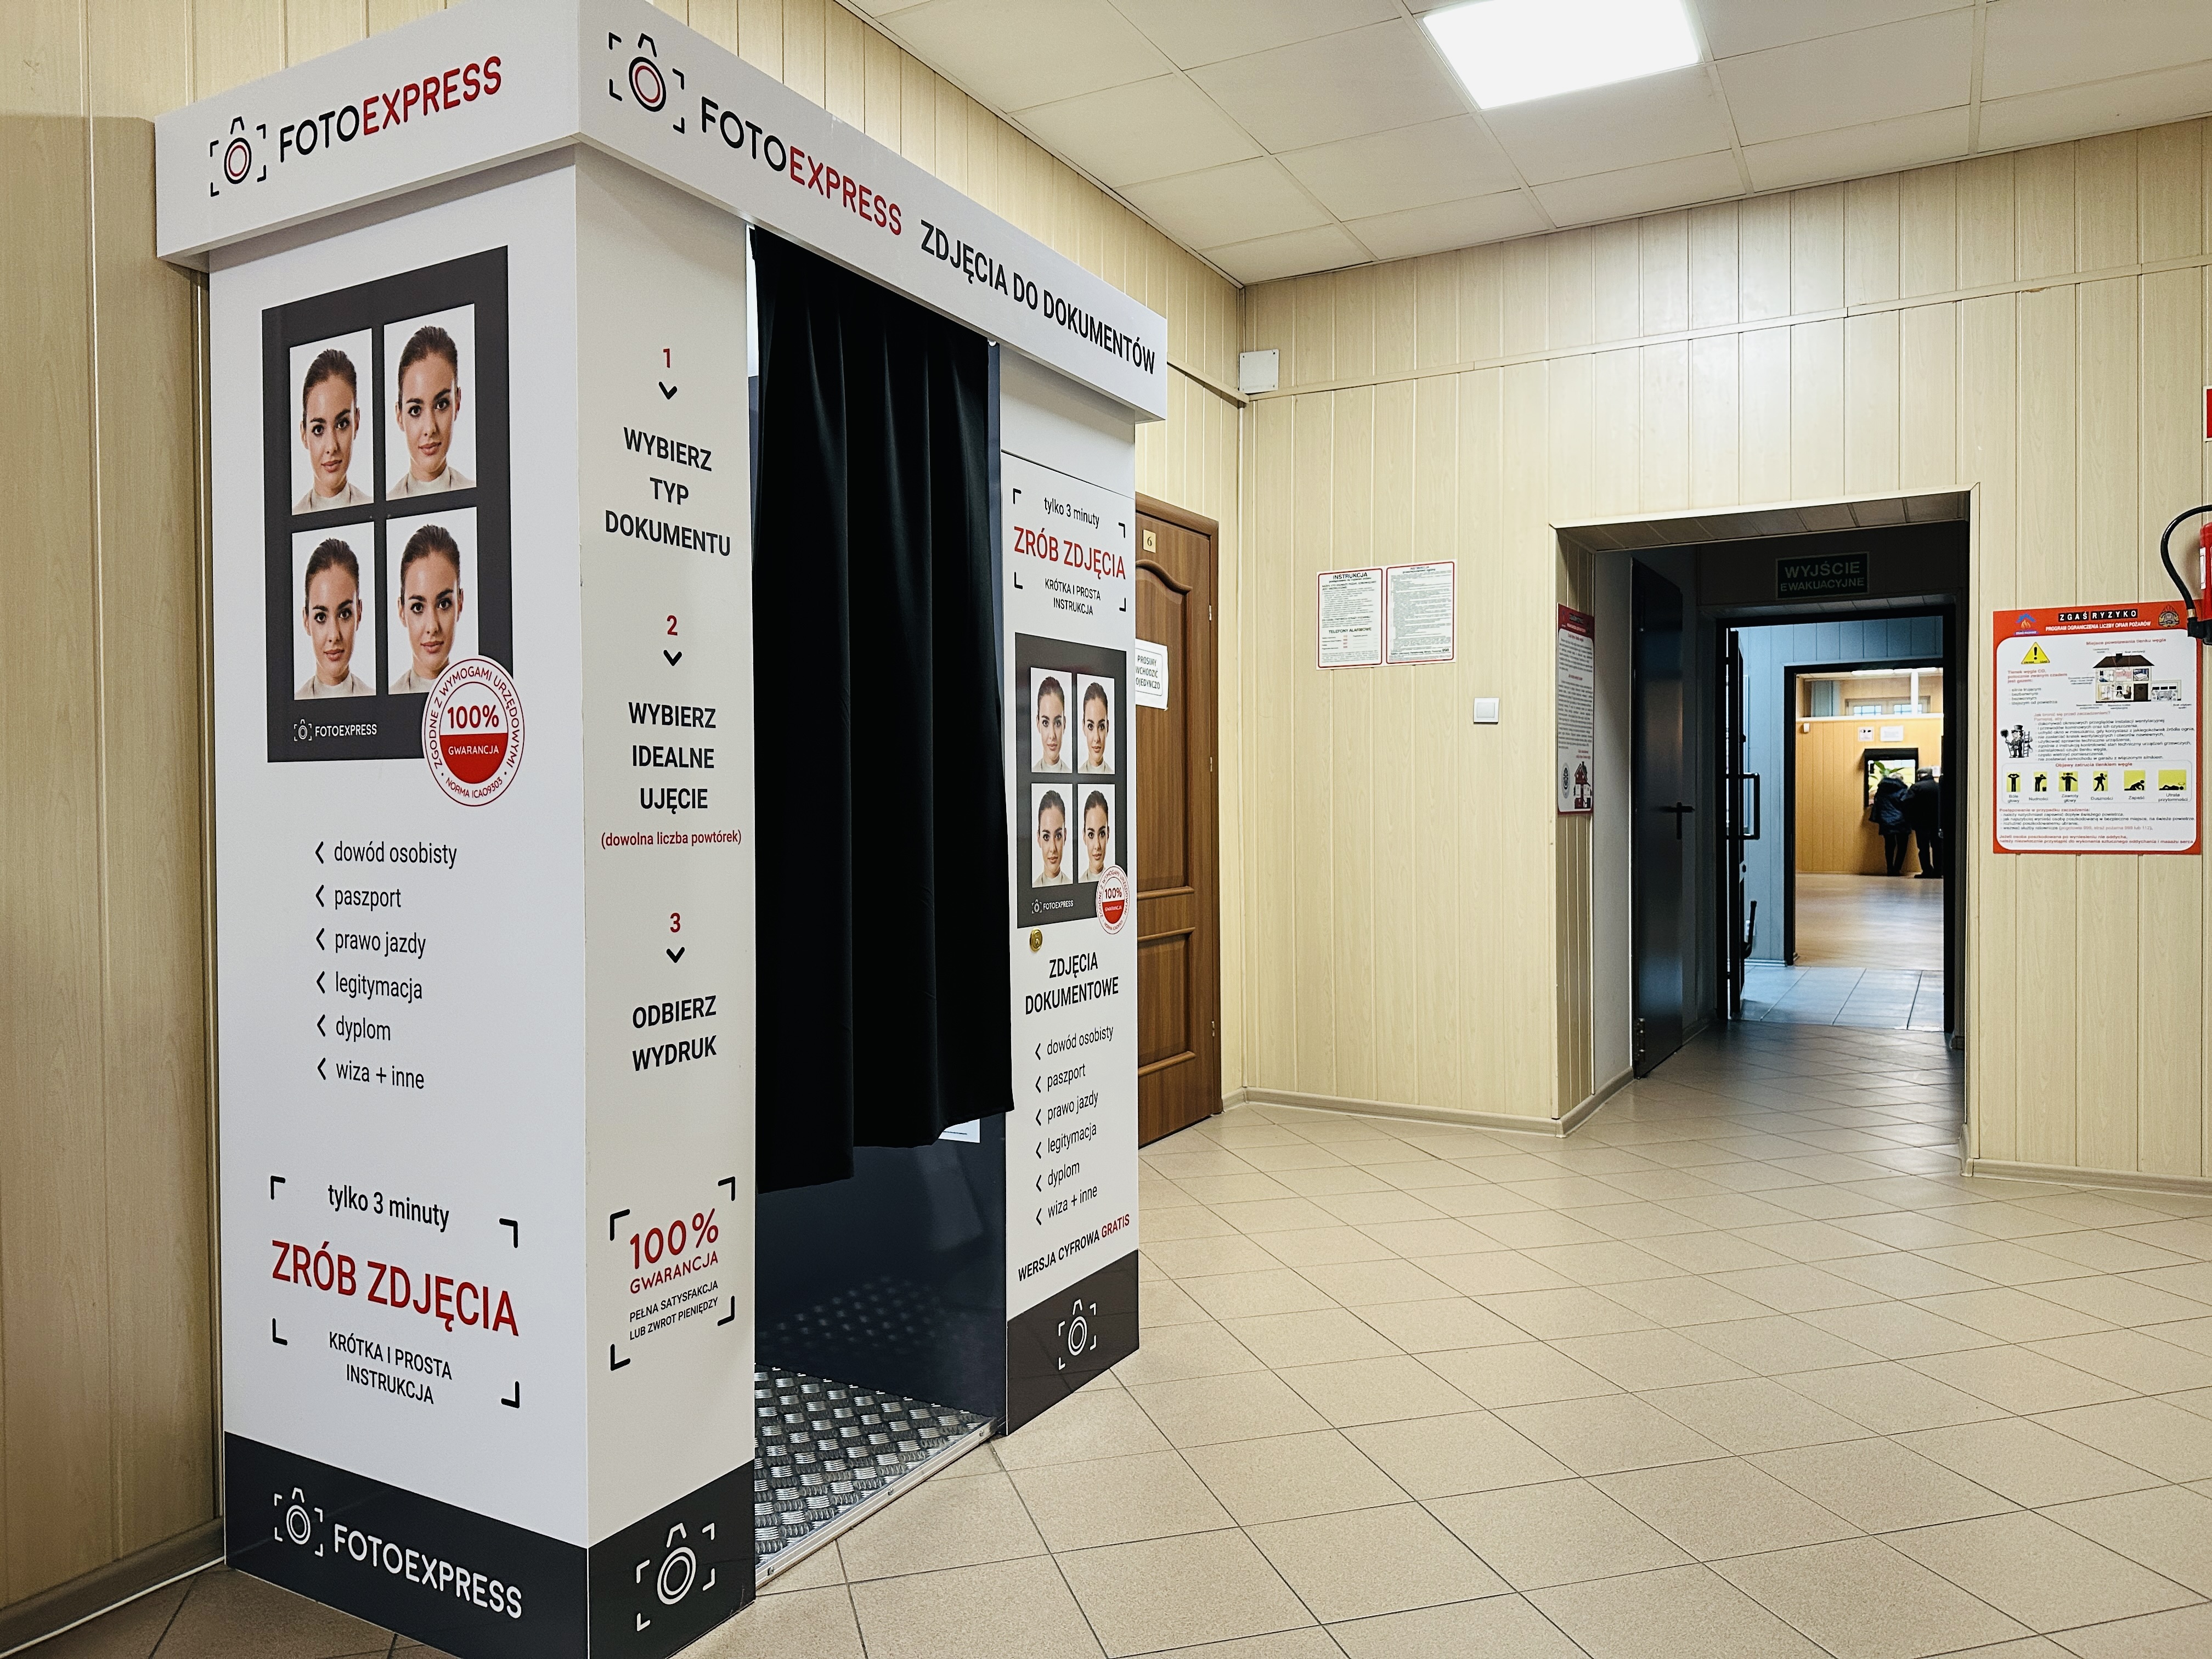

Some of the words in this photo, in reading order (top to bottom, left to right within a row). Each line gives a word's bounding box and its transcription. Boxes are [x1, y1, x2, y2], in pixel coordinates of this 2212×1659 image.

[278, 55, 502, 163] FOTOEXPRESS
[702, 96, 902, 235] FOTOEXPRESS
[921, 219, 1008, 296] ZDJĘCIA
[1013, 272, 1038, 310] DO
[1043, 289, 1155, 375] DOKUMENTÓW
[663, 348, 670, 368] 1
[624, 427, 712, 471] WYBIERZ
[650, 477, 689, 505] TYP
[1044, 497, 1064, 515] tylko
[1066, 504, 1071, 517] 3
[1074, 508, 1099, 529] minuty
[606, 510, 730, 556] DOKUMENTU
[1147, 536, 1152, 547] 6
[1014, 526, 1059, 561] ZRÓB
[1064, 540, 1126, 579] ZDJĘCIA
[1785, 561, 1860, 578] WYJŚCIE
[1045, 578, 1071, 594] KRÓTKA
[1073, 585, 1074, 594] I
[1076, 586, 1101, 601] PROSTA
[1781, 578, 1864, 591] EWAKUACYJNE
[1053, 597, 1093, 616] INSTRUKCJA
[2060, 612, 2087, 620] ZGAŚ
[2092, 611, 2136, 619] RYZYKO
[667, 615, 678, 636] 2
[1136, 666, 1158, 678] WCHODZIĆ
[1138, 655, 1156, 666] PROSIMY
[439, 666, 492, 696] WYMOGAMI
[1136, 678, 1160, 689] OJEDYNCZO
[434, 697, 443, 709] Z
[448, 704, 499, 729] 100%
[628, 702, 716, 729] WYBIERZ
[315, 724, 377, 737] FOTOEXPRESS
[493, 675, 520, 768] URZĘDOWYMI
[429, 709, 443, 769] ZGODNE
[448, 745, 499, 755] GWARANCJA
[632, 745, 714, 768] IDEALNE
[445, 777, 470, 798] NORMA
[472, 777, 503, 799] ICAO9303
[640, 788, 708, 814] UJĘCIE
[601, 832, 653, 849] (dowolna
[657, 831, 689, 844] liczba
[691, 830, 742, 847] powtórek)
[334, 840, 384, 862] dowód
[389, 842, 457, 869] osobisty
[335, 888, 401, 911] paszport
[1105, 887, 1122, 899] 100%
[670, 912, 681, 933] 3
[335, 933, 381, 953] prawo
[384, 932, 426, 960] jazdy
[1049, 952, 1098, 978] ZDJĘCIA
[335, 972, 422, 1003] legitymacja
[1025, 977, 1119, 1015] DOKUMENTOWE
[633, 995, 716, 1029] ODBIERZ
[336, 1015, 391, 1042] dyplom
[1047, 1034, 1077, 1056] dowód
[1079, 1026, 1114, 1048] osobisty
[632, 1035, 716, 1071] WYDRUK
[336, 1060, 370, 1082] wiza
[376, 1067, 387, 1084] +
[392, 1066, 425, 1090] inne
[1047, 1064, 1086, 1092] paszport
[1047, 1101, 1075, 1124] prawo
[1076, 1091, 1098, 1114] jazdy
[1048, 1122, 1097, 1154] legitymacja
[1047, 1161, 1080, 1188] dyplom
[328, 1184, 368, 1212] tylko
[373, 1192, 383, 1214] 3
[389, 1197, 449, 1233] minuty
[1048, 1200, 1068, 1218] wiza
[1080, 1185, 1097, 1204] inne
[630, 1207, 719, 1269] 100%
[1018, 1251, 1056, 1282] WERSJA
[1058, 1229, 1100, 1261] CYFROWA
[1101, 1214, 1130, 1239] GRATIS
[630, 1250, 718, 1294] GWARANCJA
[272, 1239, 357, 1296] ZRÓB
[367, 1260, 519, 1337] ZDJĘCIA
[630, 1304, 659, 1323] PEŁNA
[661, 1280, 718, 1311] SATYSFAKCJA
[630, 1327, 646, 1340] LUB
[647, 1313, 677, 1334] ZWROT
[678, 1297, 718, 1321] PIENIĘDZY
[329, 1331, 383, 1362] KRÓTKA
[387, 1347, 390, 1363] I
[395, 1349, 452, 1380] PROSTA
[347, 1364, 434, 1404] INSTRUKCJA
[334, 1523, 523, 1620] FOTOEXPRESS
